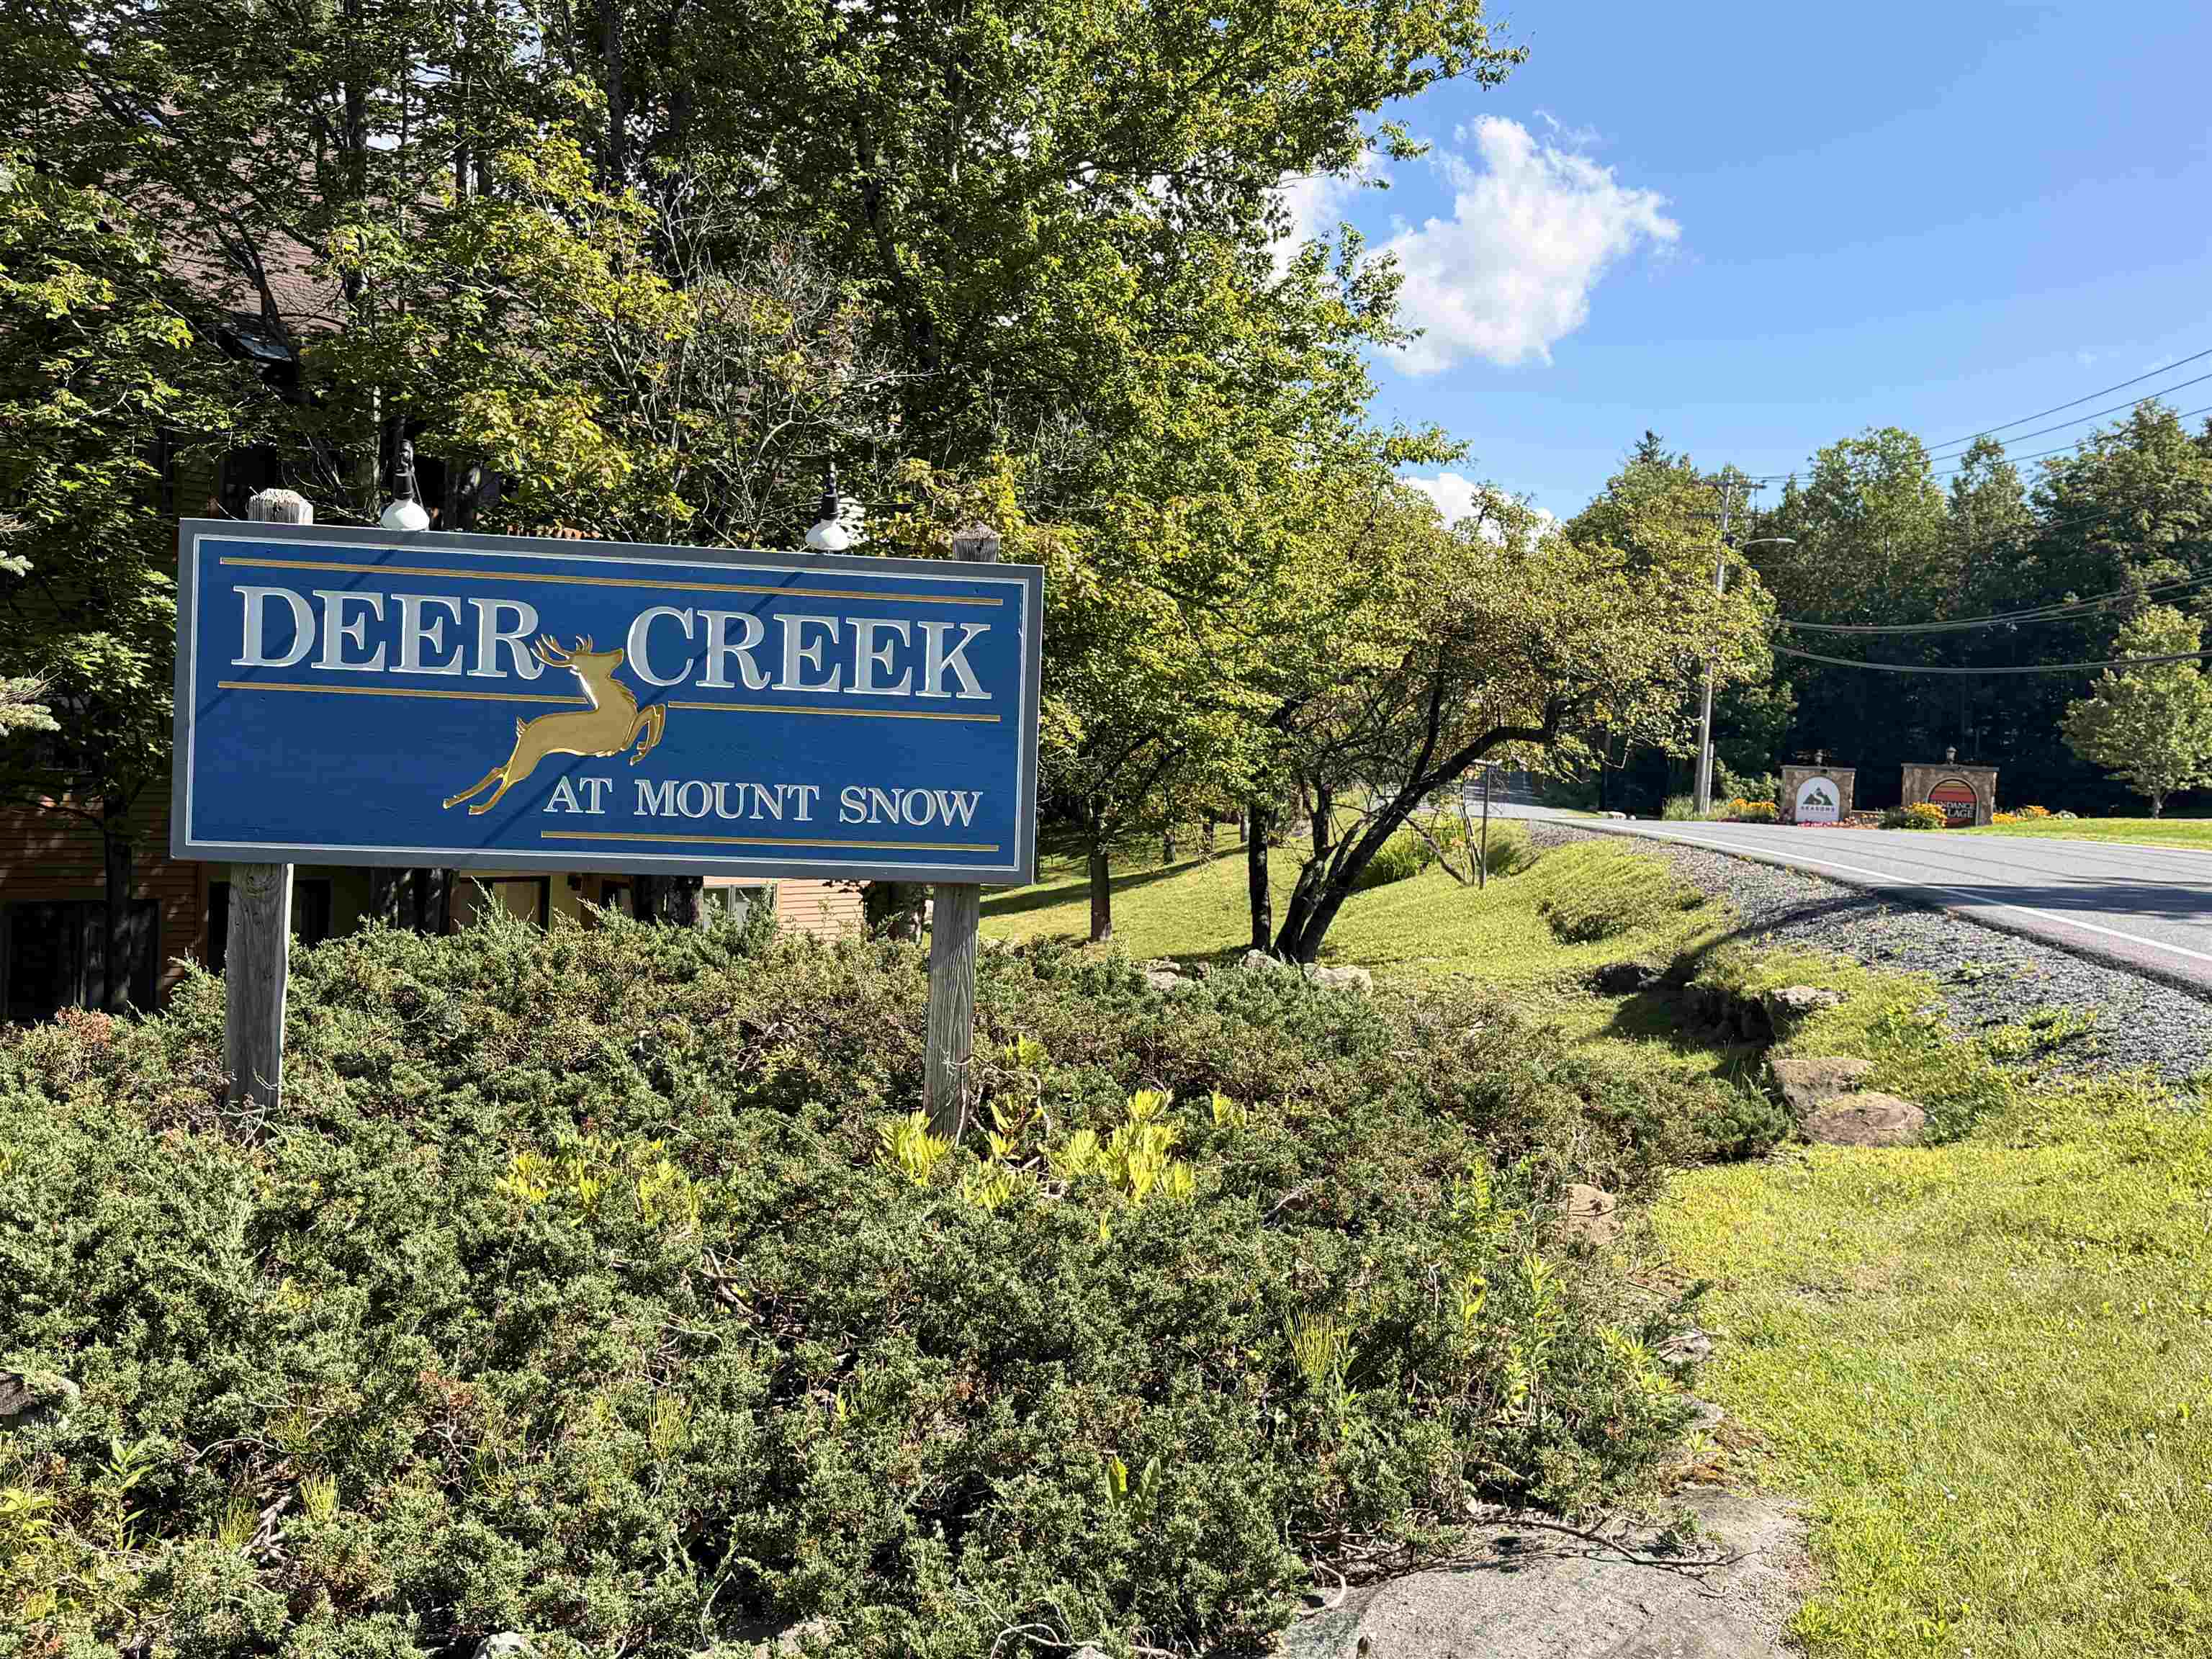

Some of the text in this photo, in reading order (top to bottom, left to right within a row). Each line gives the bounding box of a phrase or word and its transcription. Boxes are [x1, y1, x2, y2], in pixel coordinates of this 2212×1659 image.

[231, 585, 992, 700] DEER CREEK
[544, 775, 983, 827] AT MOUNT SNOW
